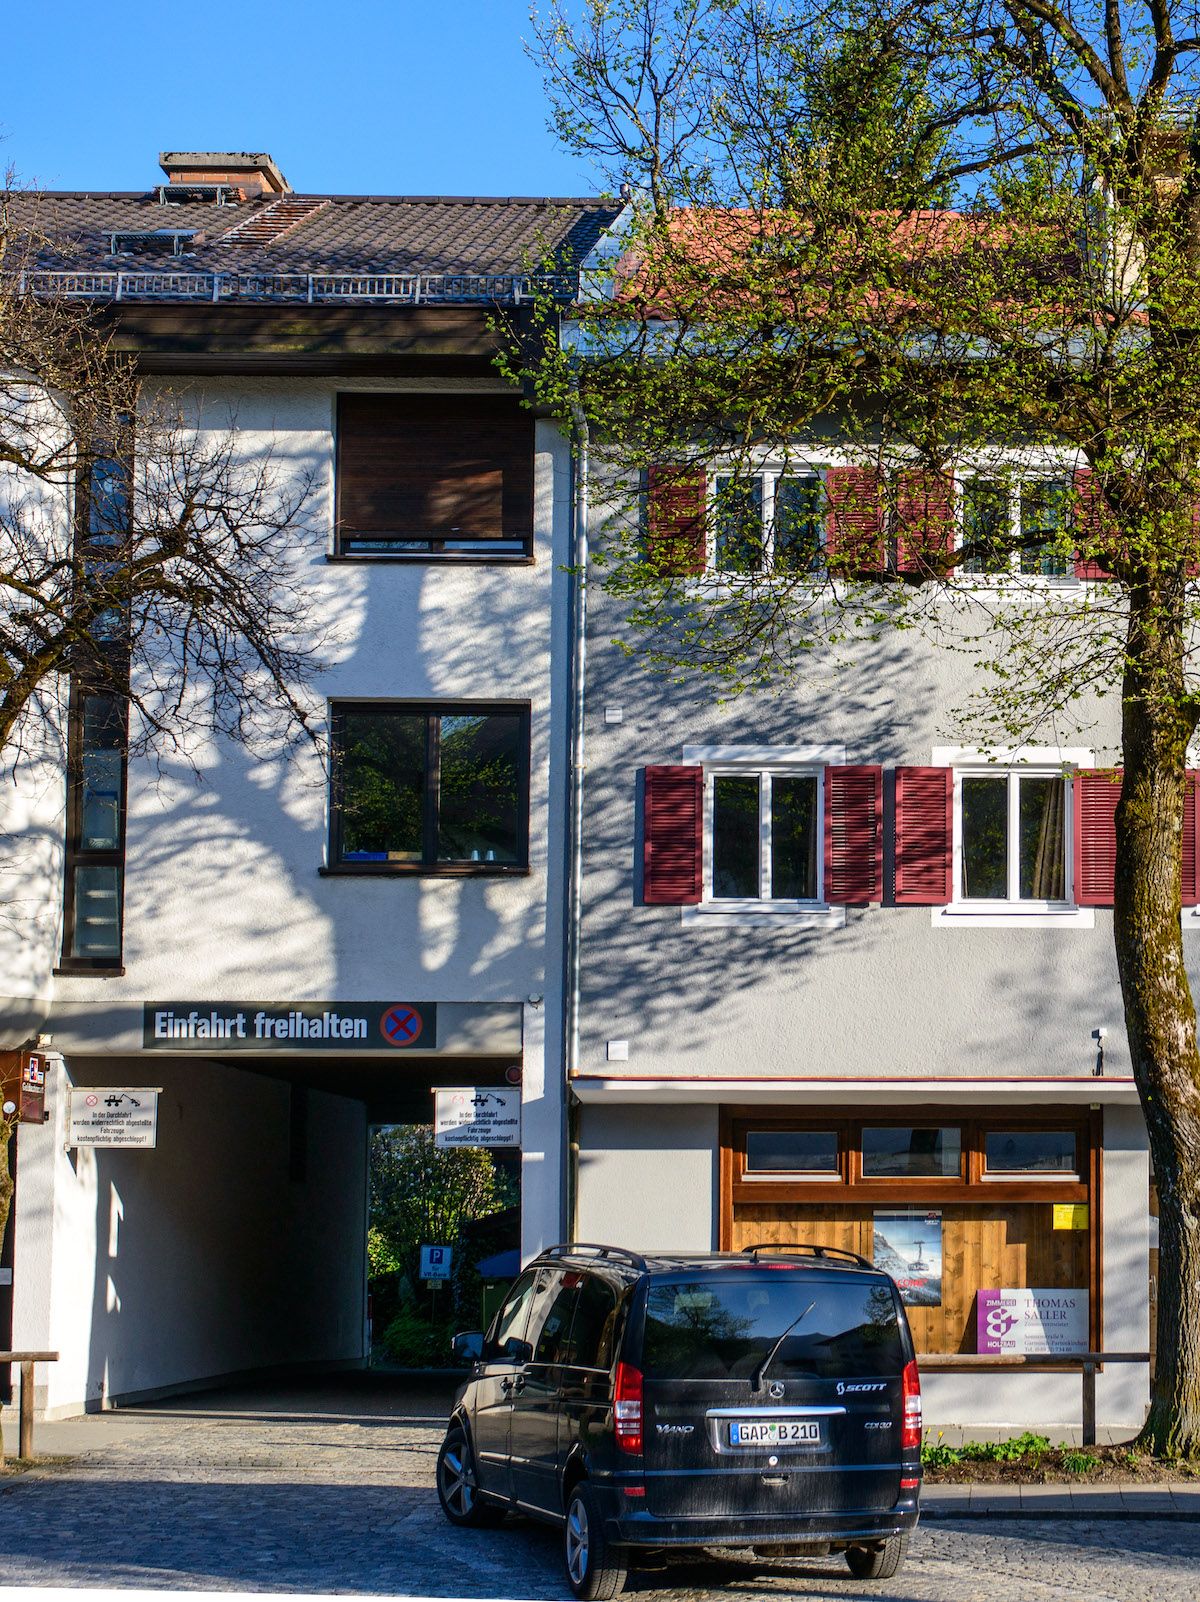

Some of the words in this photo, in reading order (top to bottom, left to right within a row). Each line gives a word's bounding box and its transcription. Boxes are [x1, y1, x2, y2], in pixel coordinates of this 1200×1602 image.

[154, 1011, 246, 1039] Einfahrt
[254, 1011, 368, 1039] freihalten
[100, 1127, 125, 1135] Fahrzeuge
[77, 1135, 112, 1143] kostenpflichtig
[432, 1250, 441, 1263] P
[986, 1299, 1016, 1307] ZIMMEREI
[1024, 1298, 1076, 1308] THOMAS
[1024, 1310, 1067, 1320] SALLER
[987, 1340, 1016, 1348] HOLZBAU
[845, 1382, 887, 1392] SCOTT
[656, 1424, 695, 1434] VIANO
[739, 1426, 769, 1442] GAP
[778, 1426, 788, 1440] B
[791, 1424, 818, 1440] 210
